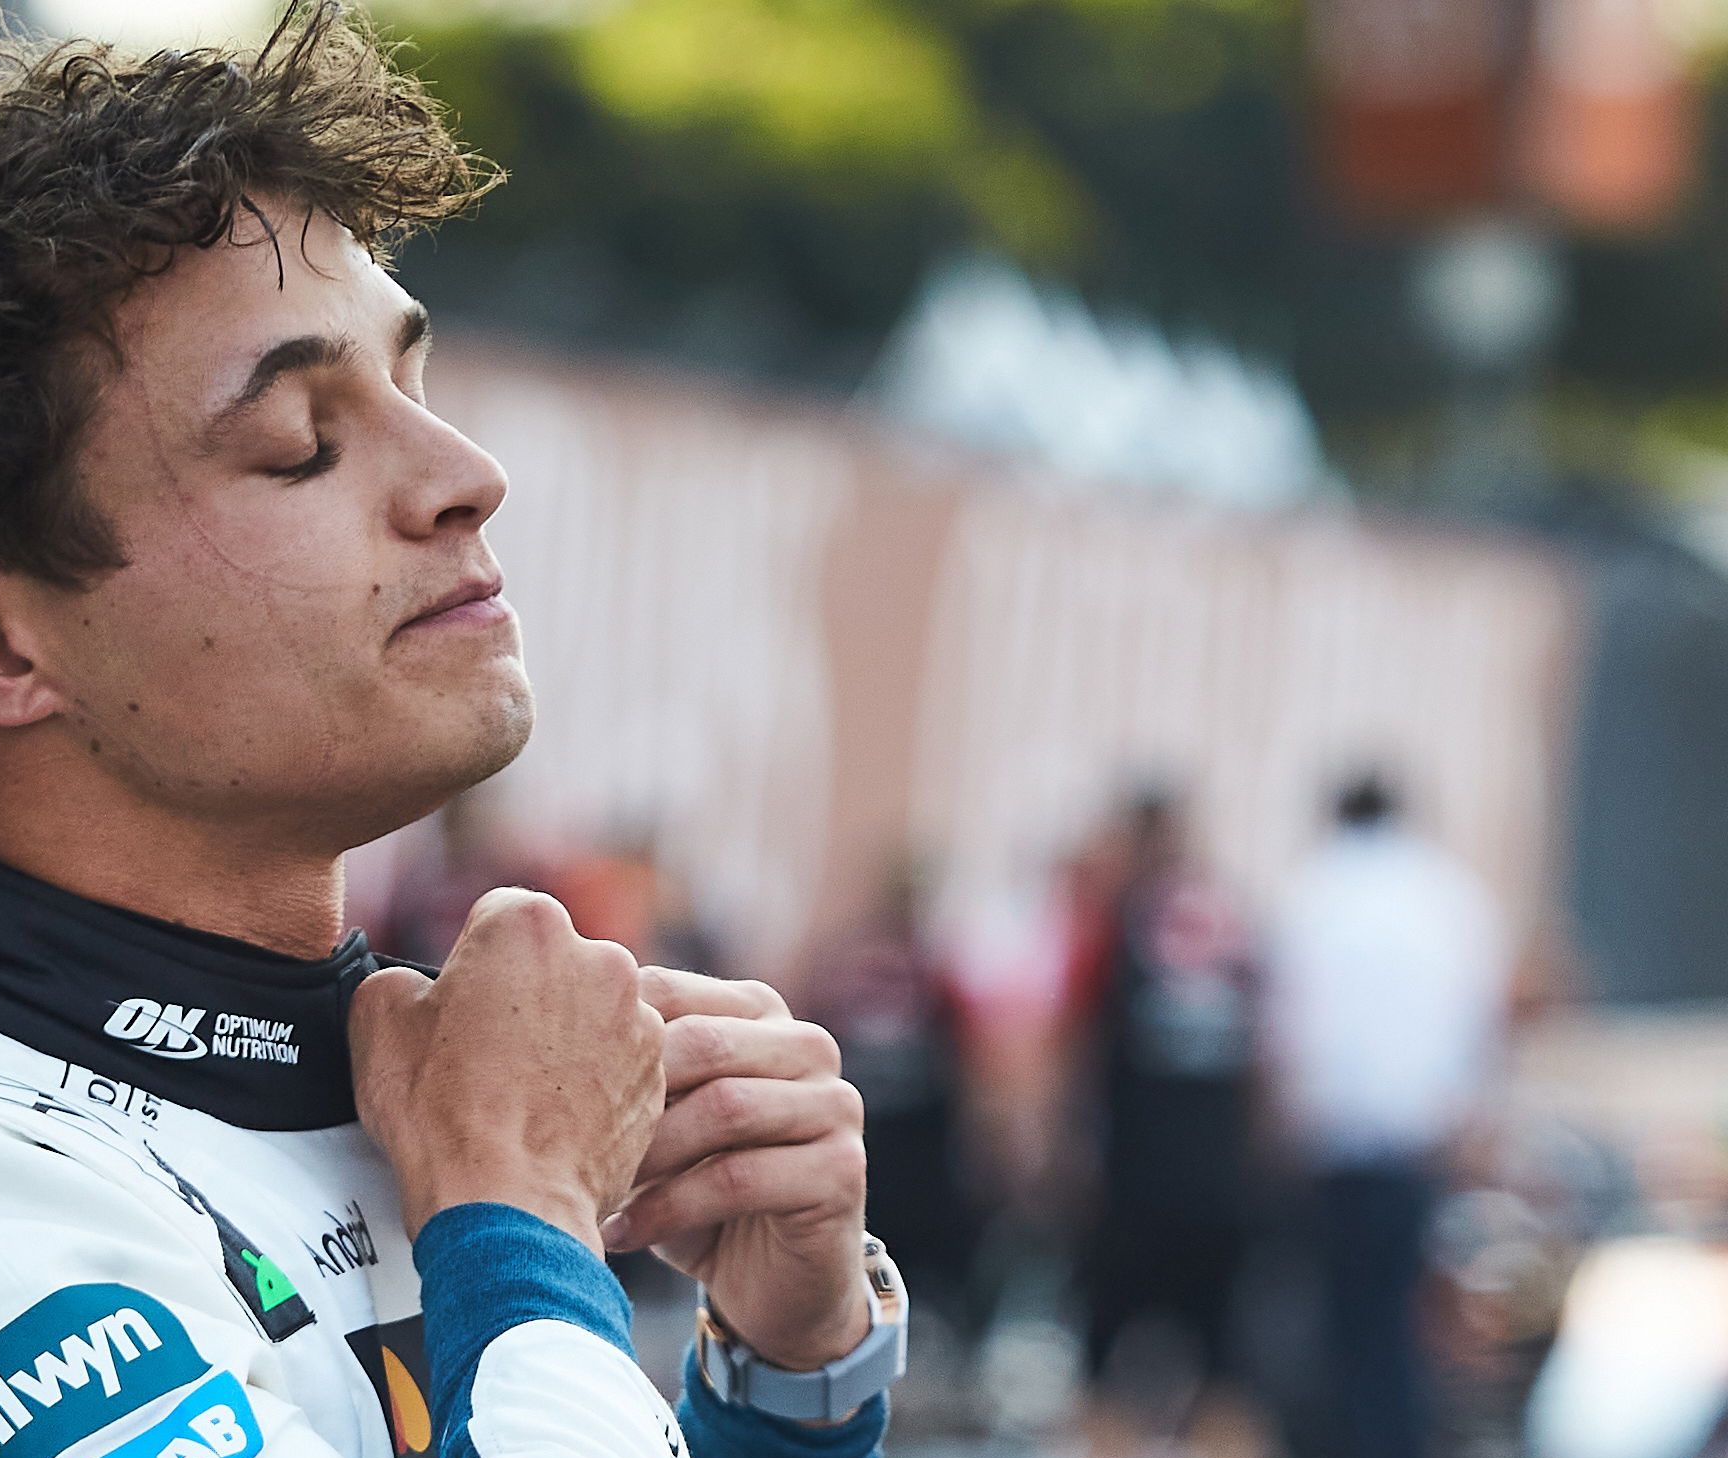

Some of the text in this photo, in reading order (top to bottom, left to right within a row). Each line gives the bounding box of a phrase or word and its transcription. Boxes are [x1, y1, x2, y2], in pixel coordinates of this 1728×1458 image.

[104, 998, 208, 1060] ON
[214, 1013, 294, 1042] OPTIMUM
[211, 1034, 300, 1065] NUTRITION
